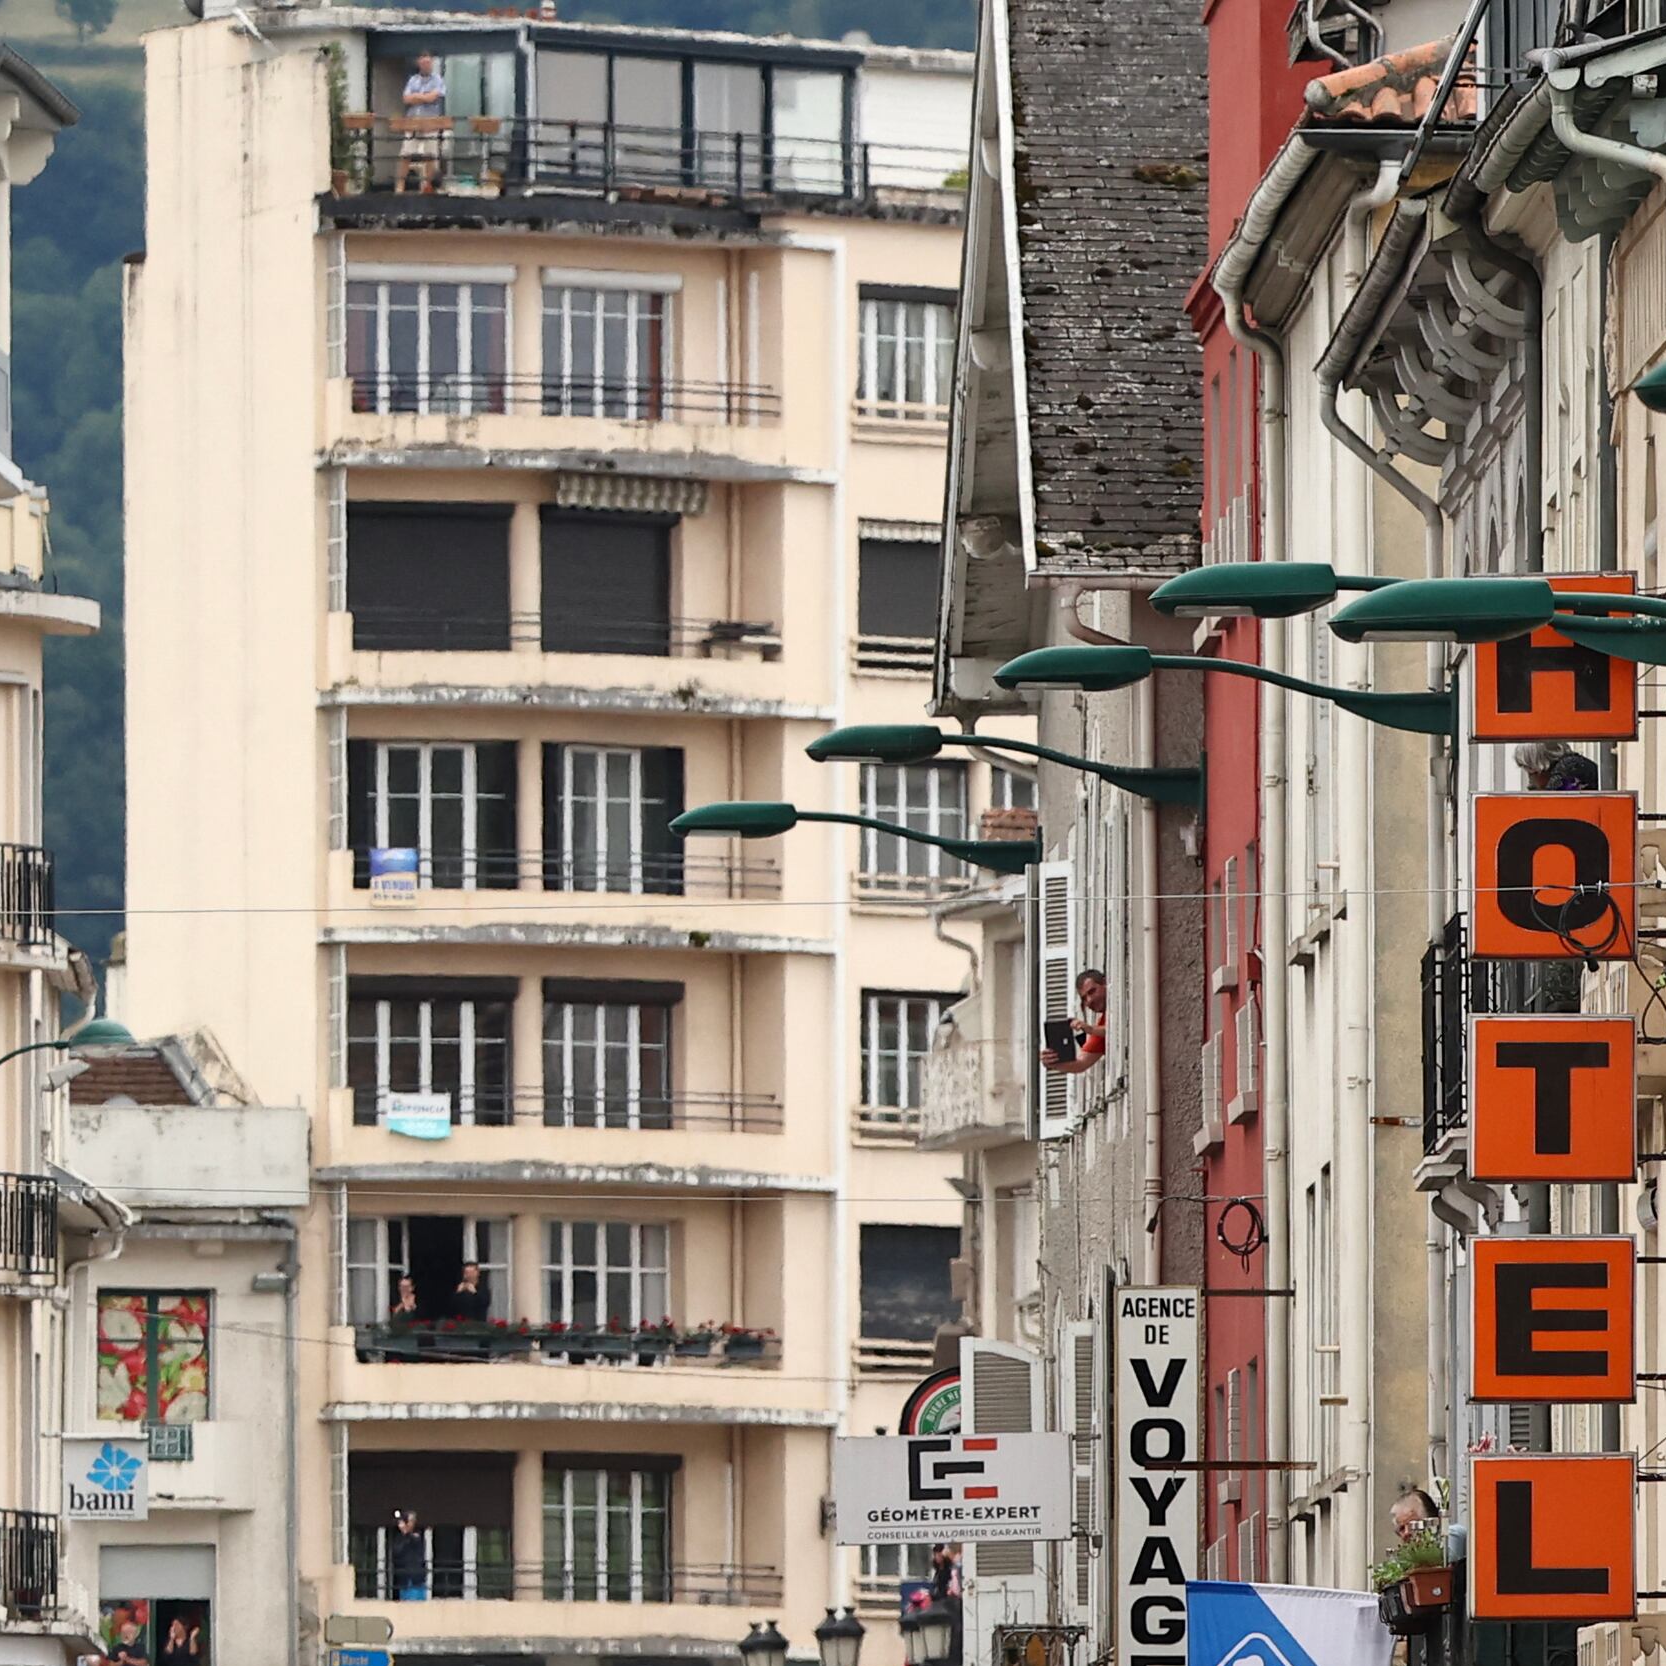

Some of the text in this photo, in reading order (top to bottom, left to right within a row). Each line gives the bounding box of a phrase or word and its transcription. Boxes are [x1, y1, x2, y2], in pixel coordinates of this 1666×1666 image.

[1494, 598, 1616, 1598] HOTEL
[1121, 1297, 1195, 1320] AGENCE
[1145, 1324, 1170, 1346] DE
[69, 1483, 135, 1511] bami
[866, 1505, 1042, 1523] GÉOMÈTRE-EXPERT
[867, 1527, 1042, 1540] CONSEILLER VALORISER GARANTIR
